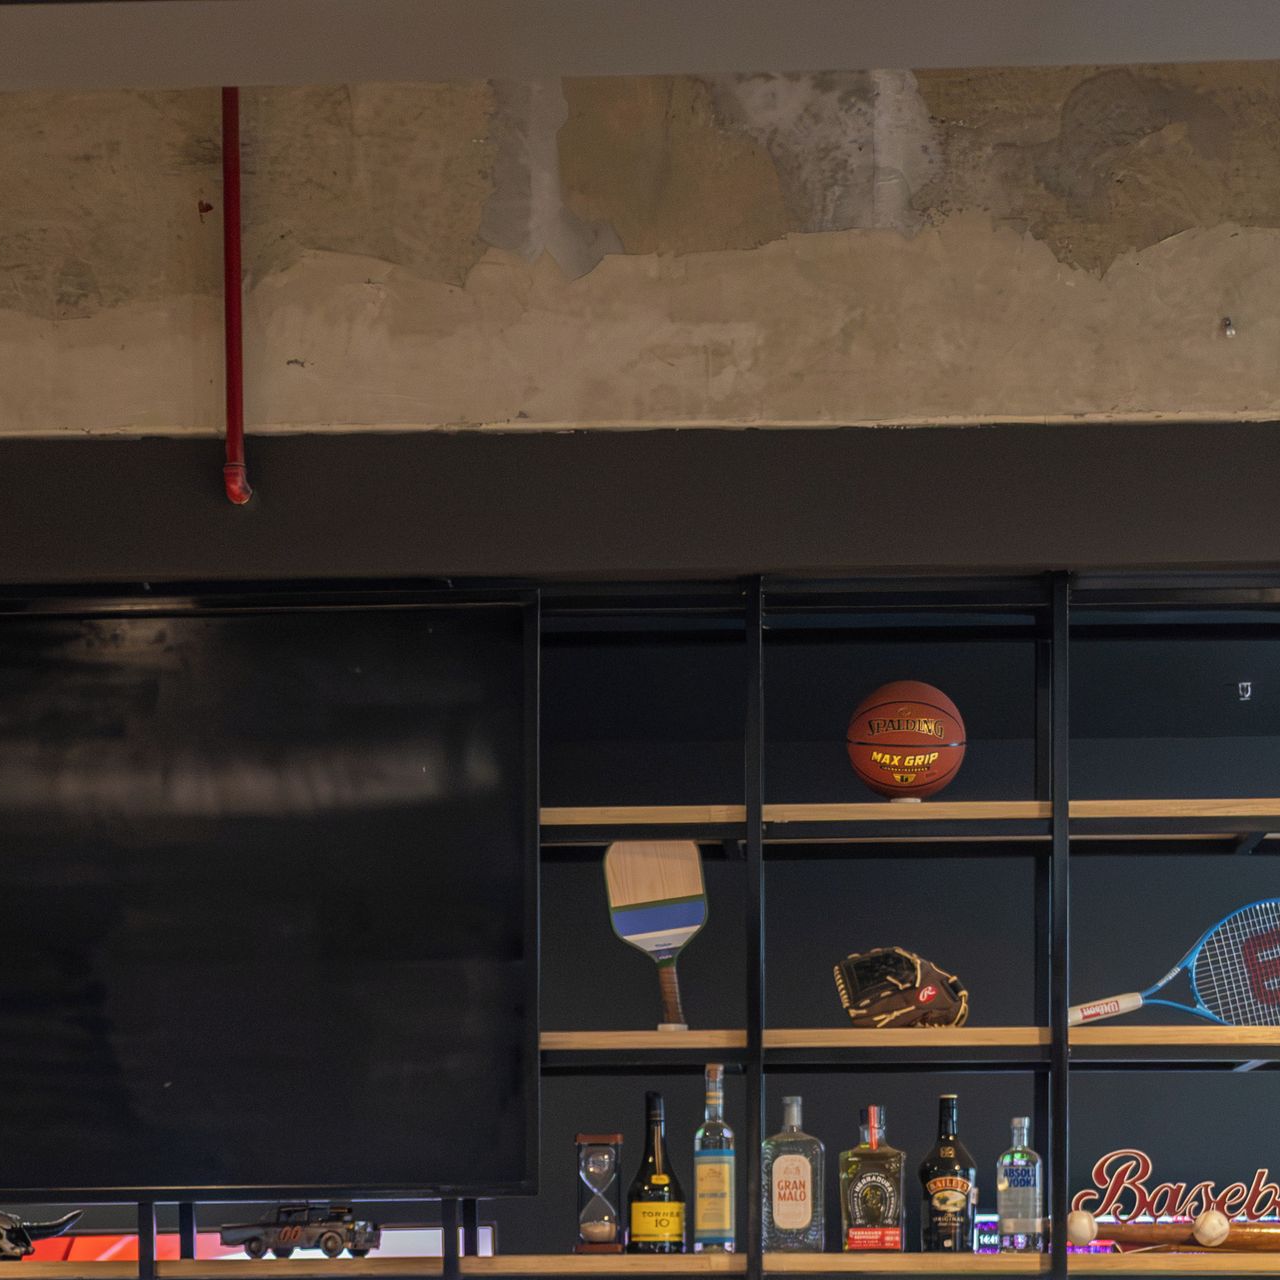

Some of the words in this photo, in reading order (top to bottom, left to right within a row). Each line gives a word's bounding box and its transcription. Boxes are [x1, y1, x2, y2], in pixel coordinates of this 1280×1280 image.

[868, 718, 945, 739] SPALDING
[871, 751, 902, 766] MAX
[904, 752, 939, 767] GRIP
[777, 1180, 806, 1191] GRAN
[777, 1191, 807, 1202] MALO
